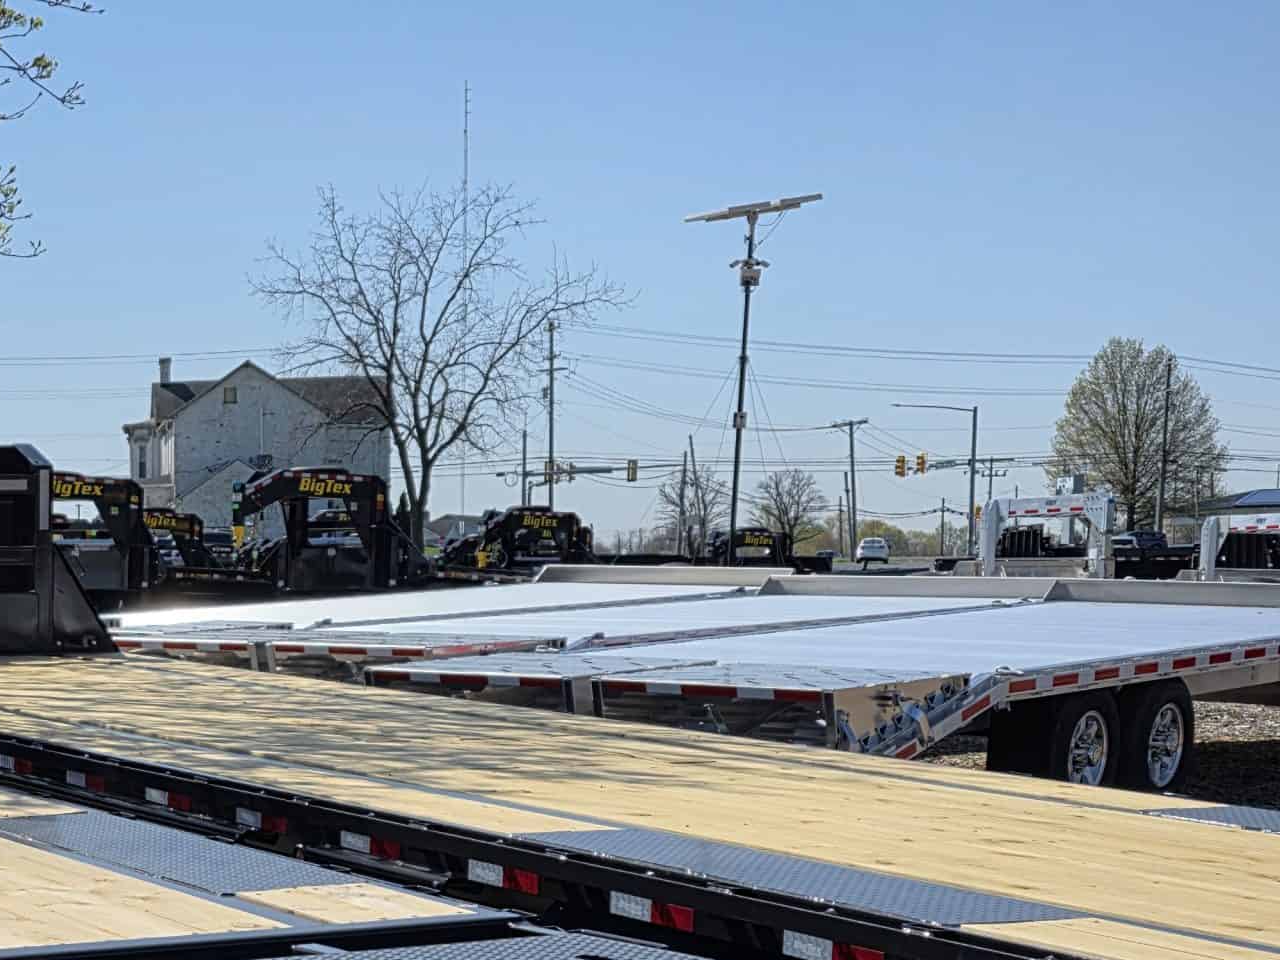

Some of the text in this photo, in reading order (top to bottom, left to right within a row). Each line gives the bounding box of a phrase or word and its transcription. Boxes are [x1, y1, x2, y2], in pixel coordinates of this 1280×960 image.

[53, 479, 103, 497] igTex
[299, 477, 353, 496] BigTex
[523, 515, 558, 529] BigTex
